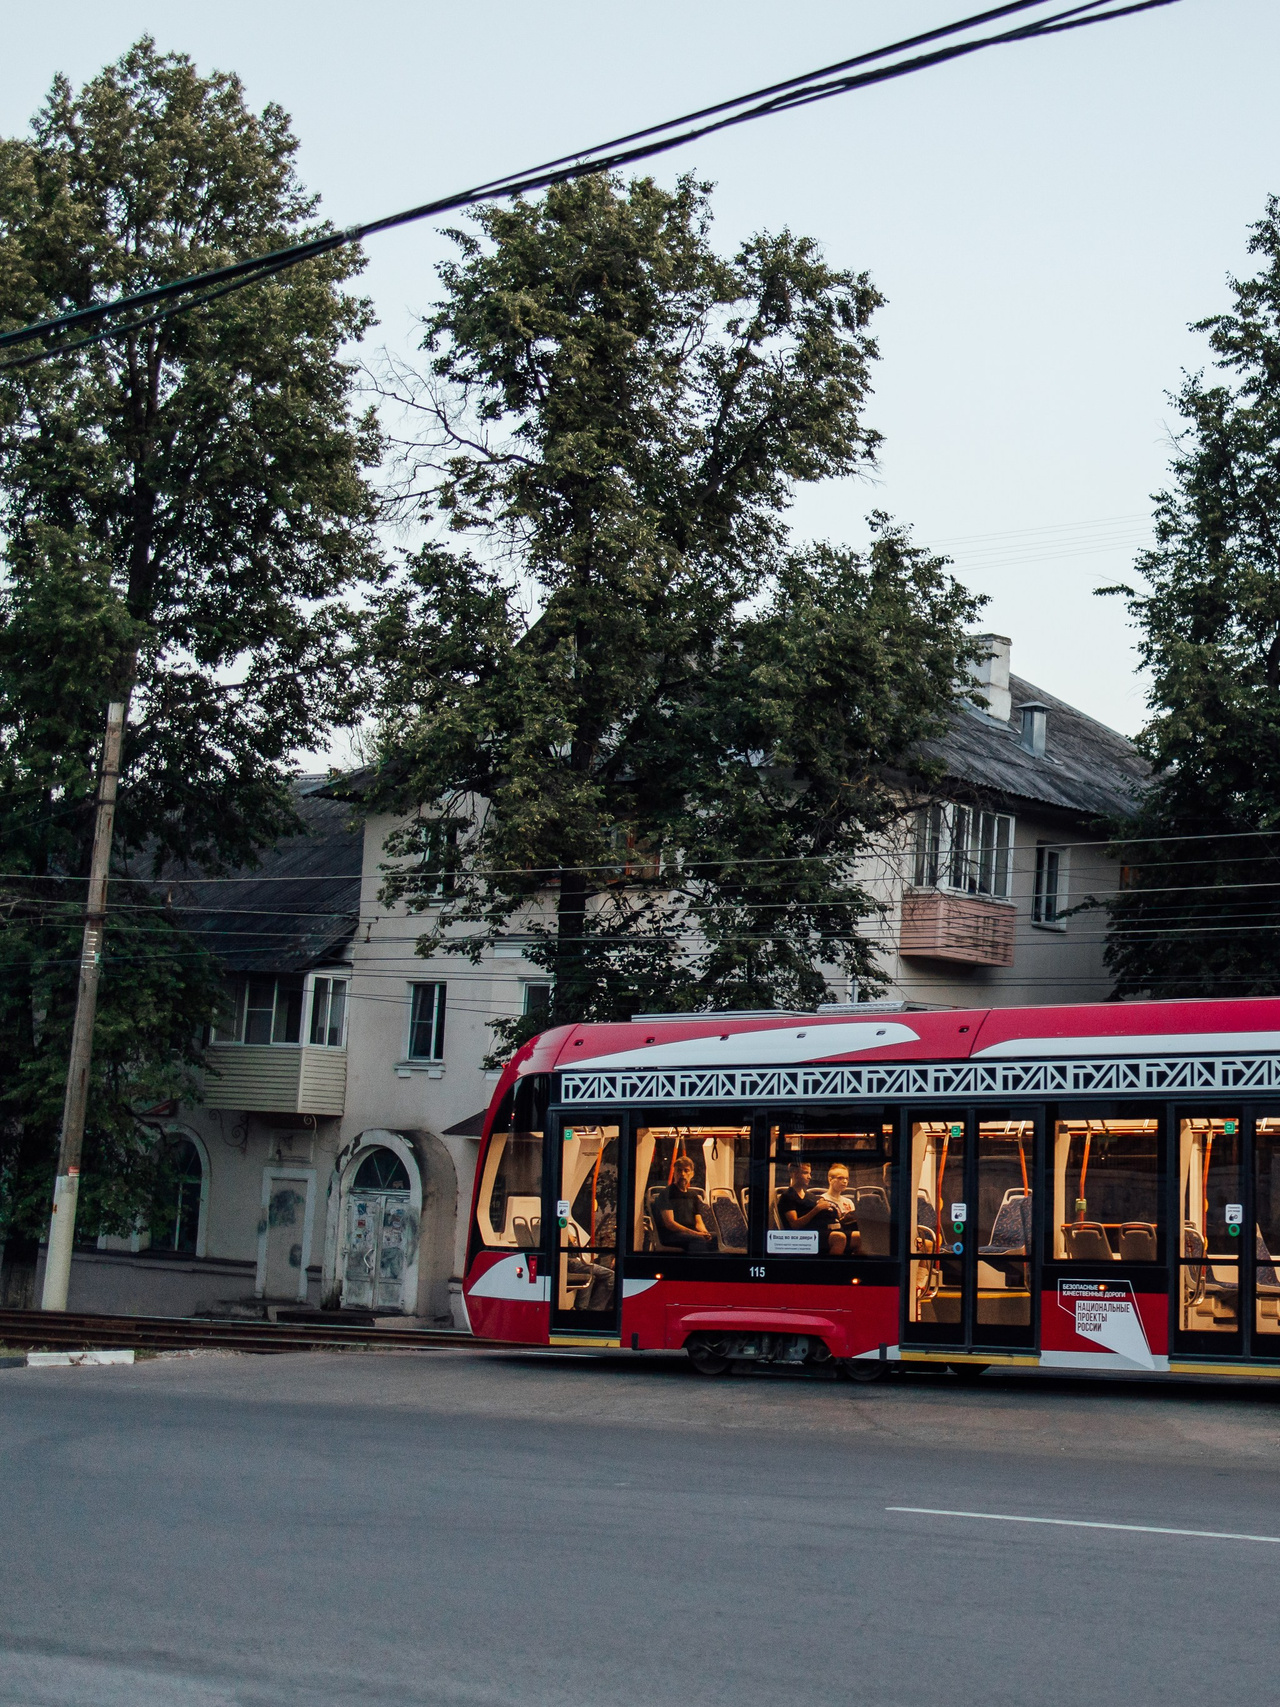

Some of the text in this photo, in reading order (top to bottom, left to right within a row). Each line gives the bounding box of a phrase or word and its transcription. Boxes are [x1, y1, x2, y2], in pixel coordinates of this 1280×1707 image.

[750, 1266, 766, 1278] 115
[1078, 1302, 1130, 1312] НАЦИОНАЛЬНЫЕ
[1078, 1312, 1108, 1322] ПРОЕКТЫ
[1078, 1322, 1102, 1332] РОССИИ
